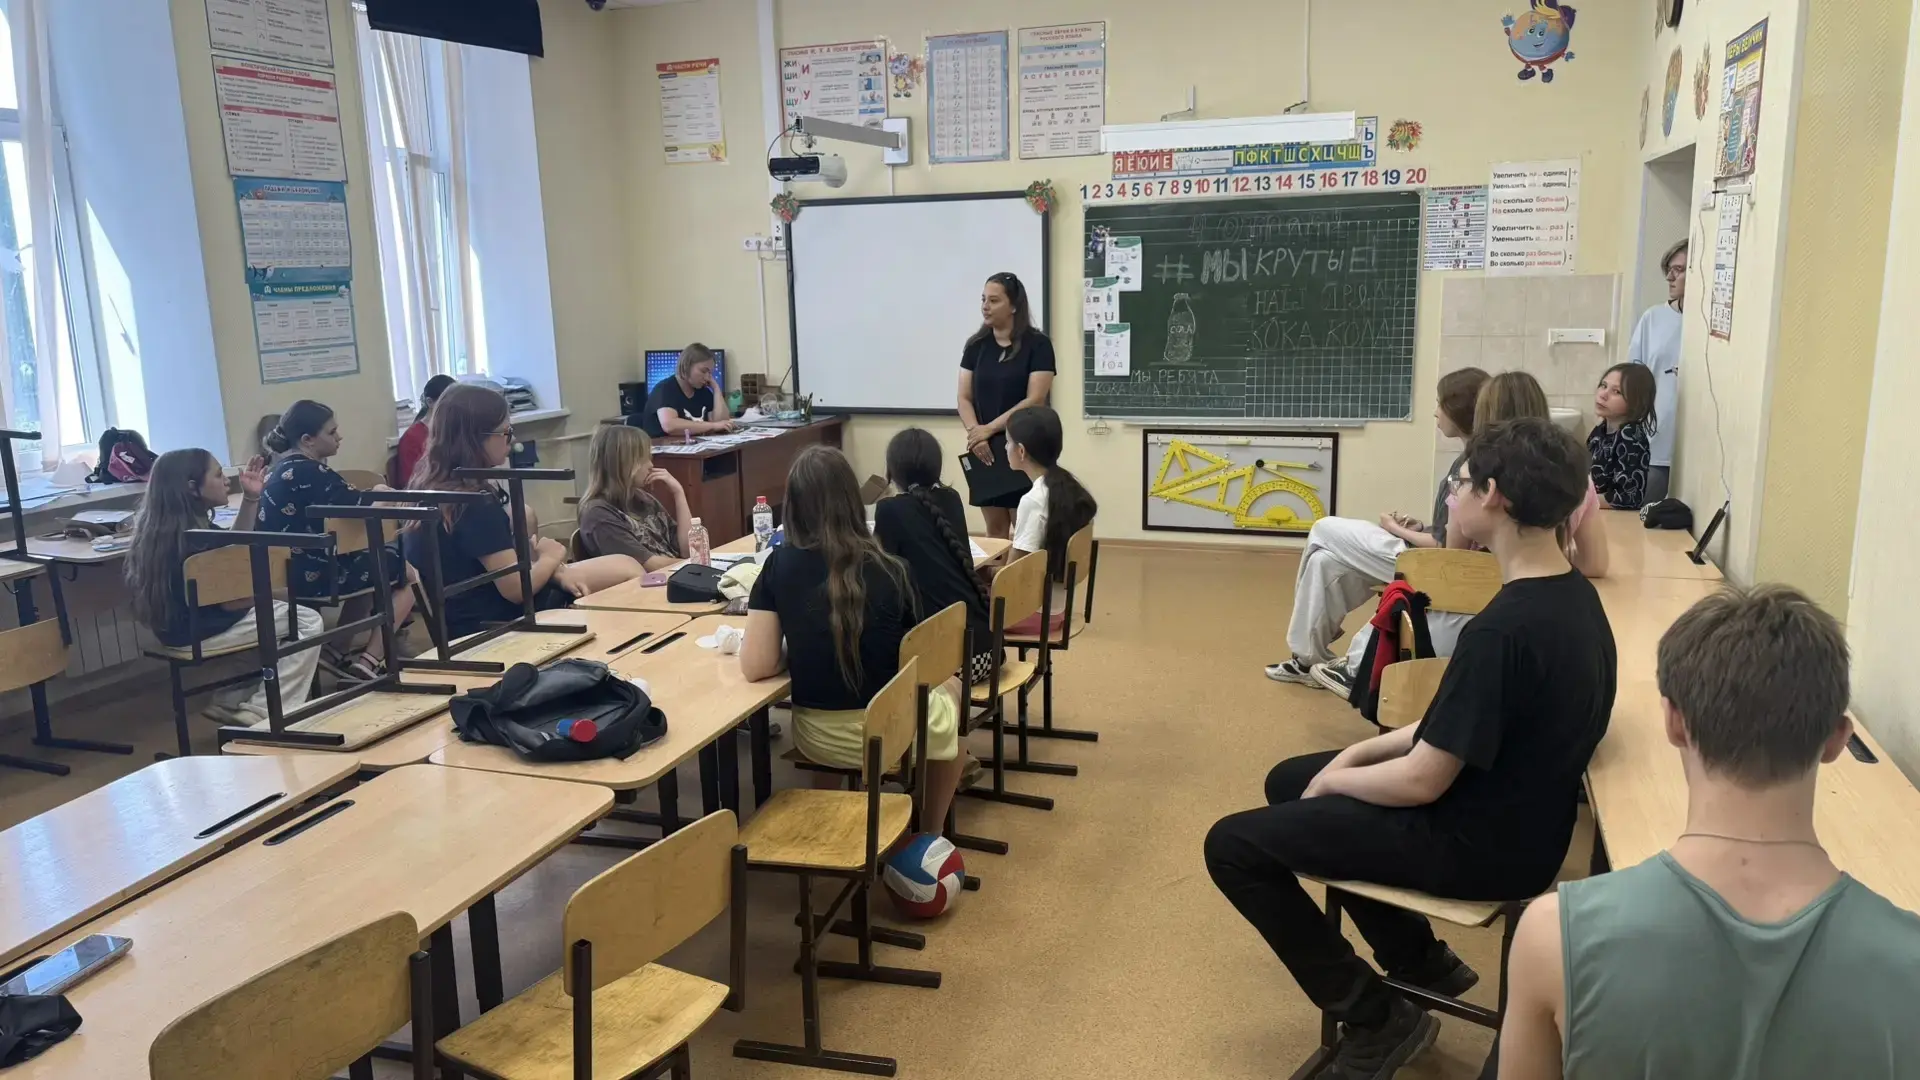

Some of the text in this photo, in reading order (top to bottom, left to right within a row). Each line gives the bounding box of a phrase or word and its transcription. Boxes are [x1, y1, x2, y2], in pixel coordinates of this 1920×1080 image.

[802, 63, 810, 75] И
[784, 72, 798, 80] ШИ
[786, 86, 797, 94] ЧУ
[803, 90, 811, 101] У
[1080, 168, 1427, 200] 1 2 3 4 5 6 7 8 9 10 11 12 13 14 15 16 17 18 19 20
[1526, 250, 1538, 258] раз
[1525, 260, 1536, 268] раз
[1130, 368, 1219, 384] МЫ РЕБЯТА
